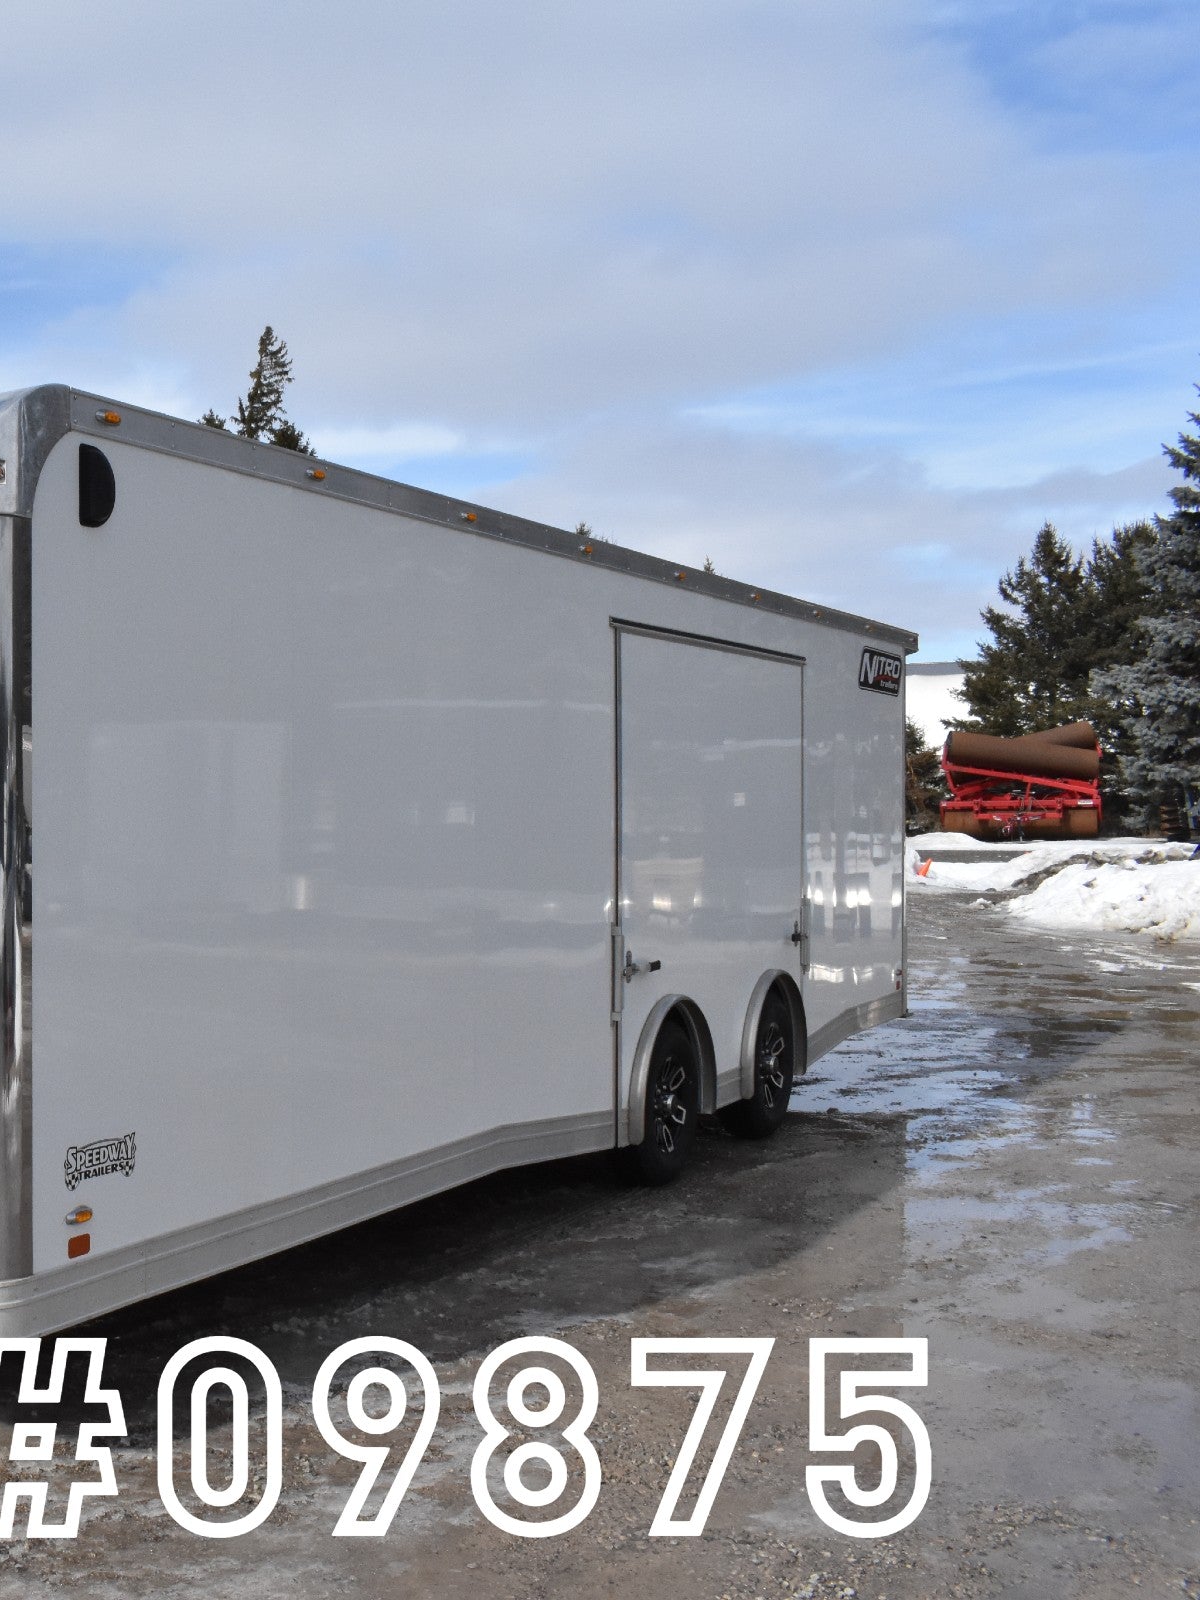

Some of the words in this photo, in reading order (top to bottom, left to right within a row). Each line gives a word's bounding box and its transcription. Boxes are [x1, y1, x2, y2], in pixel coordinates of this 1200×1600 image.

[860, 652, 900, 684] NITRO
[64, 1132, 136, 1175] SPEEDWAY
[78, 1162, 124, 1181] TRAILERS
